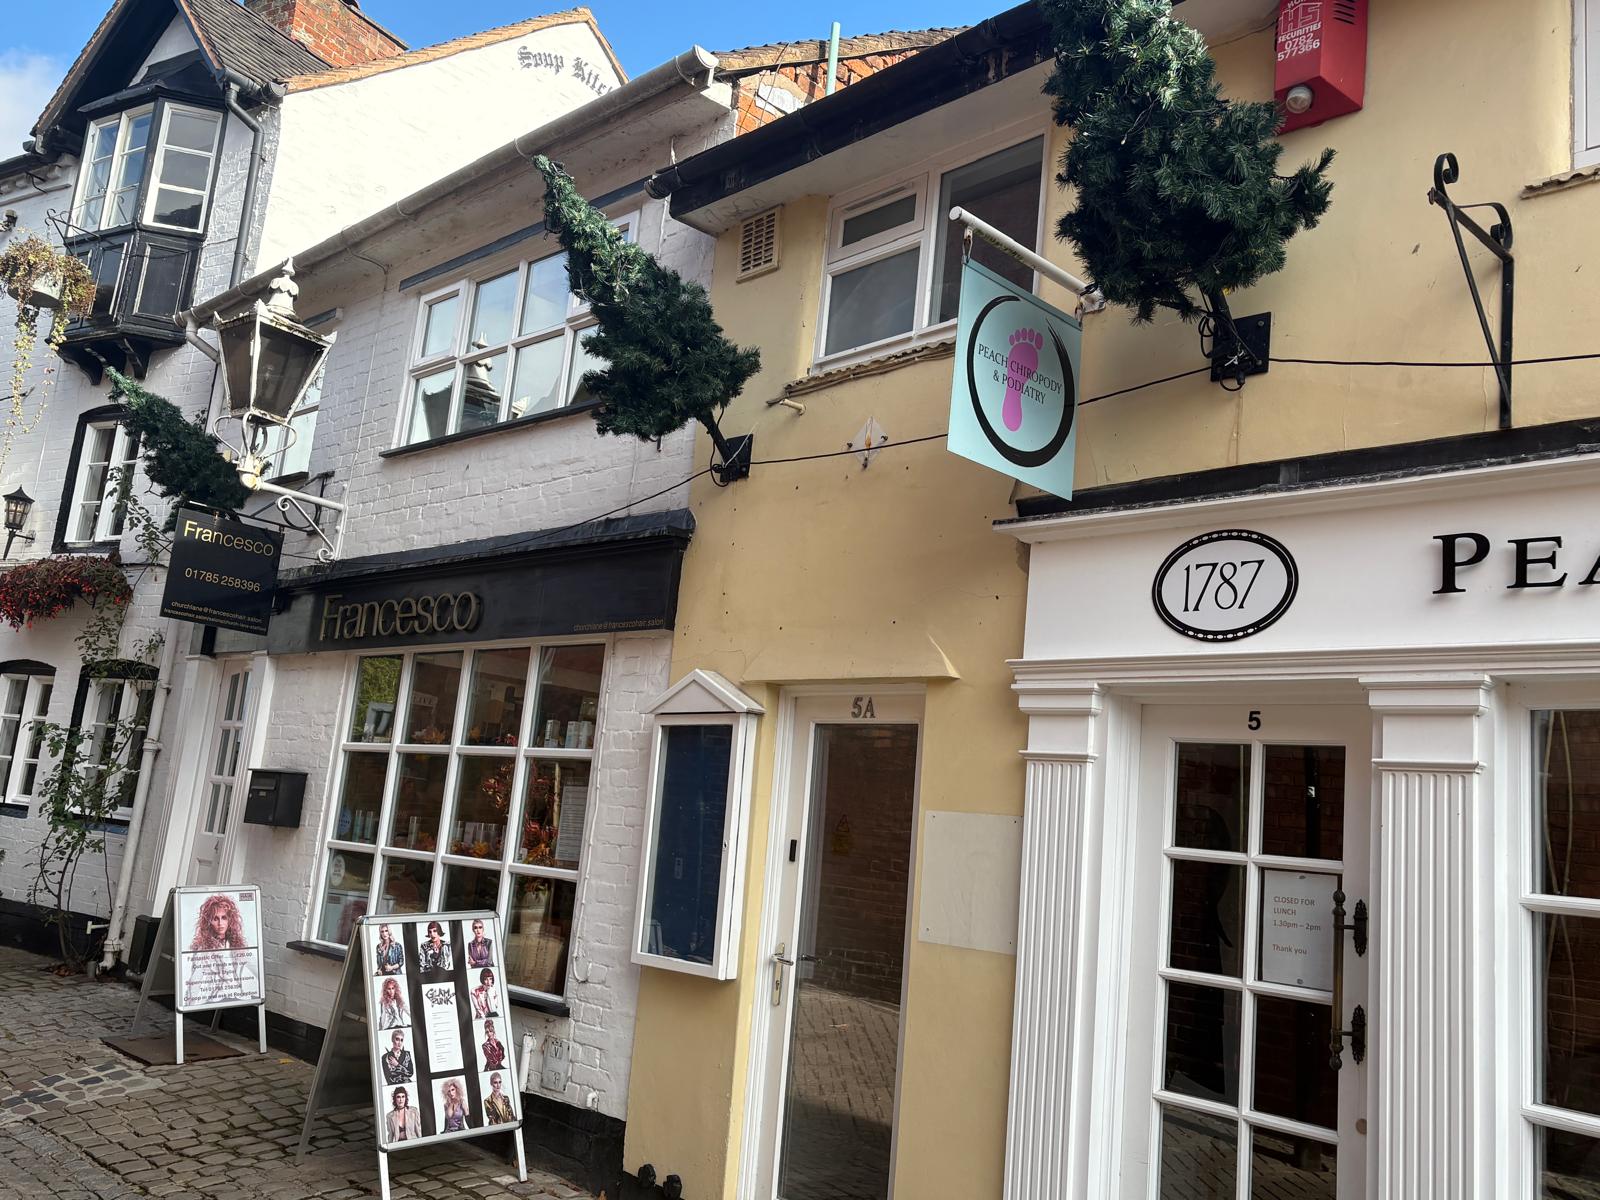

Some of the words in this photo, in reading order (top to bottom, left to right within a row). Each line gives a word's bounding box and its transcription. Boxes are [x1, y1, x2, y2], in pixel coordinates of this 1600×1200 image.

[1278, 21, 1322, 43] SECURITIES
[1285, 33, 1313, 50] 0782
[1277, 39, 1320, 61] 577366
[978, 344, 1008, 368] PEACH
[1010, 360, 1062, 394] CHIROPODY
[993, 370, 999, 382] &
[1002, 373, 1046, 404] PODIATRY
[184, 519, 274, 556] Francesco
[185, 567, 219, 583] 01785
[221, 575, 260, 592] 258396
[1183, 559, 1265, 612] 1787
[319, 591, 478, 641] Francesco
[851, 696, 876, 719] 5A
[1248, 711, 1261, 731] 5
[1273, 896, 1299, 905] CLOSED
[1300, 898, 1315, 906] FOR
[1273, 907, 1296, 916] LUNCH
[1273, 919, 1298, 929] 1.30pm
[1306, 922, 1321, 931] 2pm
[1272, 944, 1292, 953] Thank
